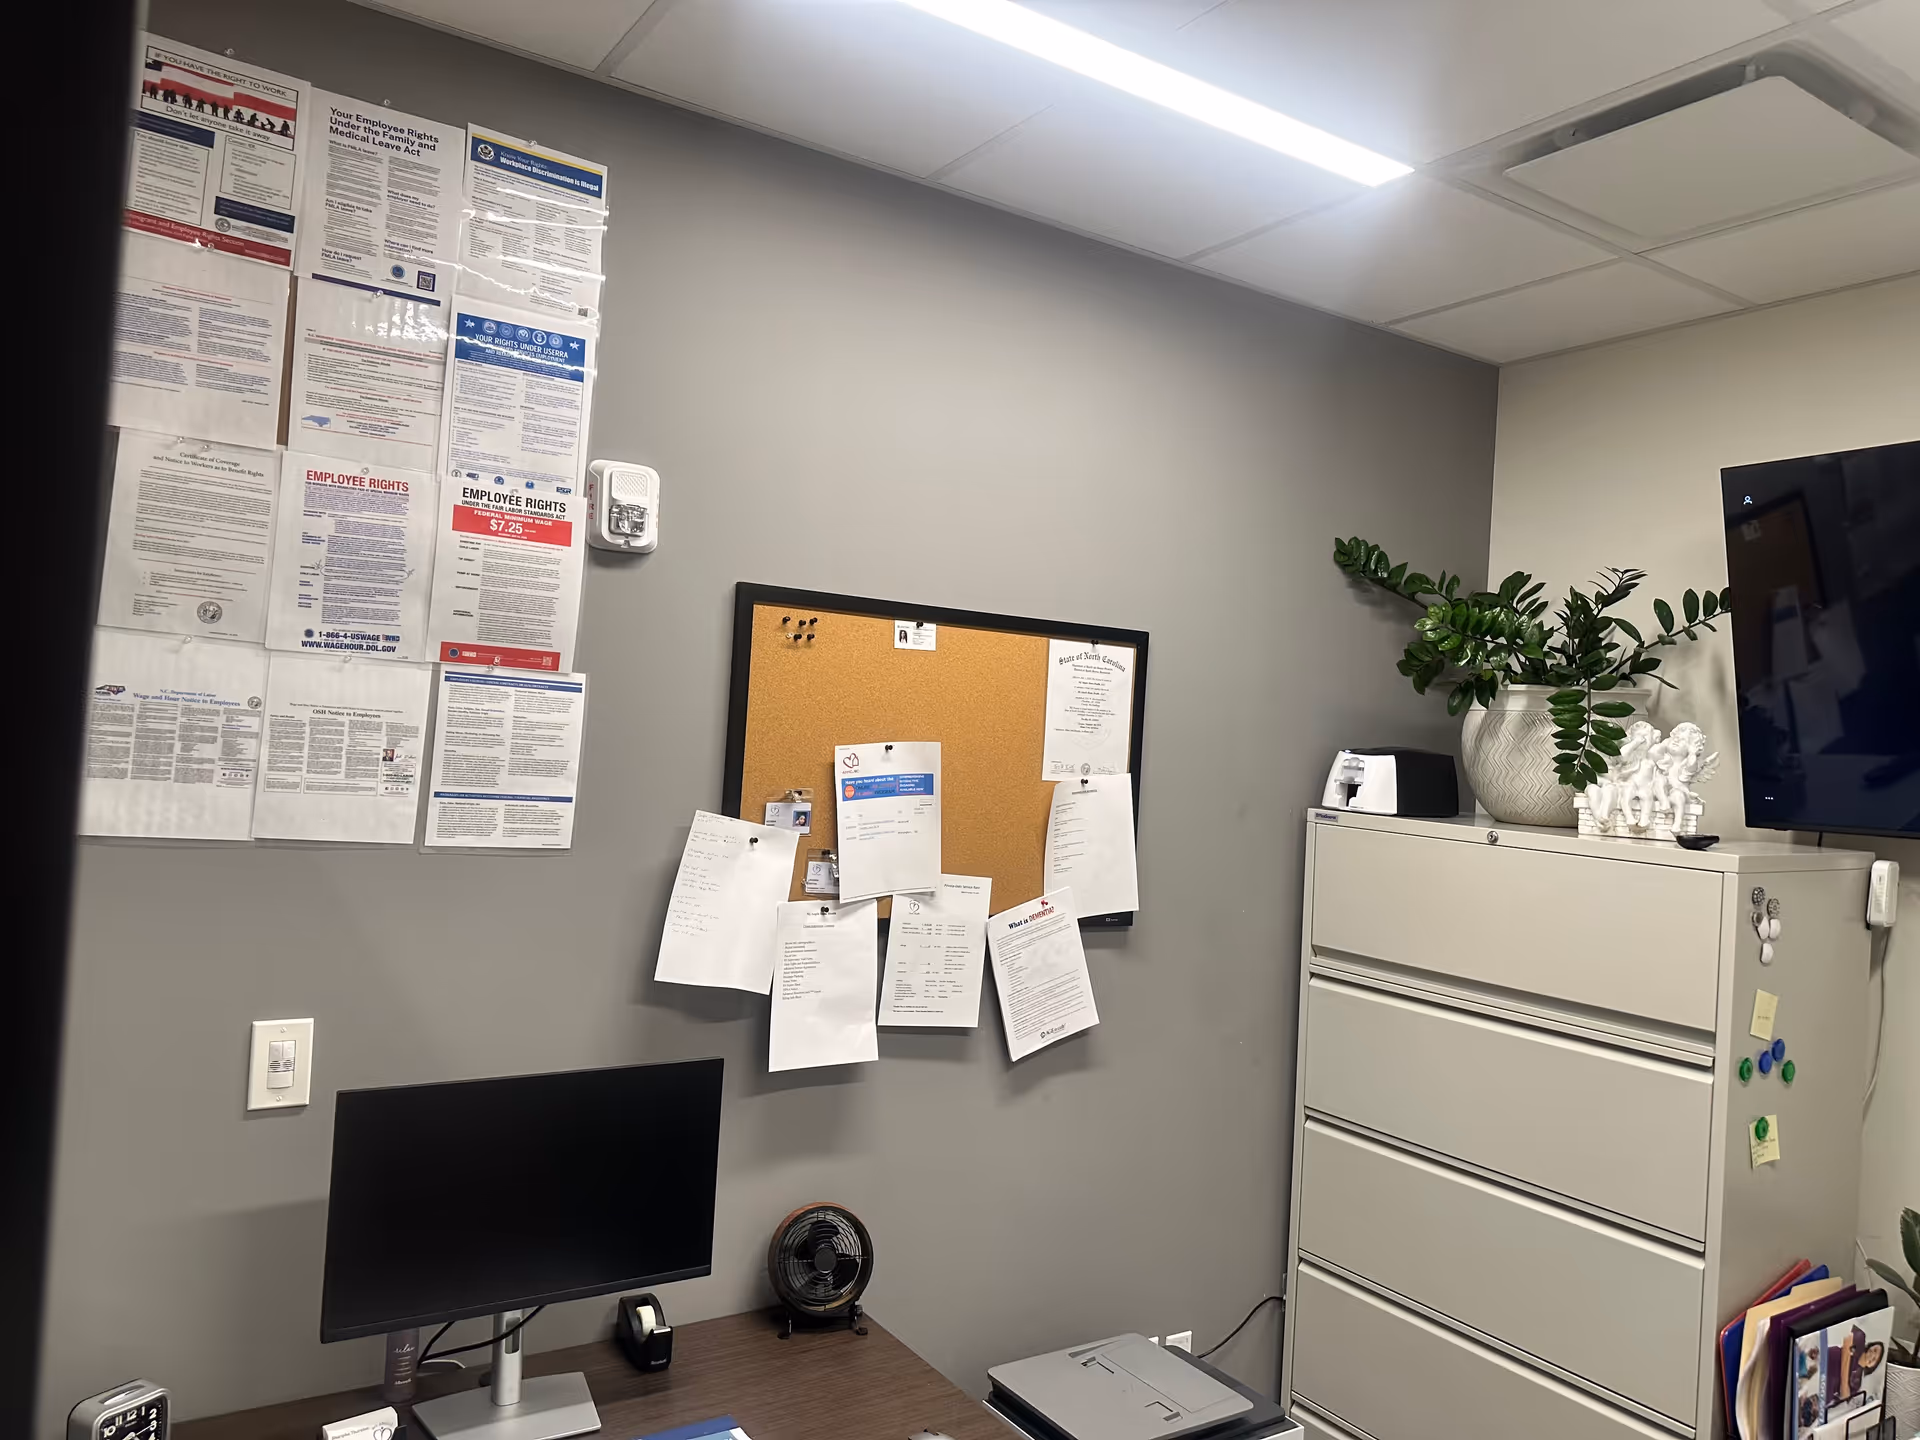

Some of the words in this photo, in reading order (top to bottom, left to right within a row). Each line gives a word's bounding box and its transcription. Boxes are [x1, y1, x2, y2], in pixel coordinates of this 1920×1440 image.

[163, 54, 182, 65] YOU
[183, 60, 205, 72] HAVE
[207, 67, 222, 78] THE
[223, 71, 246, 85] RIGHT
[248, 80, 261, 89] TO
[261, 83, 287, 97] WORK
[165, 105, 188, 118] Don't
[189, 112, 199, 121] let
[200, 117, 227, 129] anyone
[228, 123, 244, 133] take
[330, 106, 354, 120] Your
[355, 114, 405, 135] Employee
[407, 128, 439, 144] Rights
[329, 117, 361, 131] Under
[363, 126, 380, 137] the
[382, 130, 416, 147] Family
[417, 141, 436, 152] and
[329, 125, 370, 144] Medical
[372, 137, 402, 152] Leave
[403, 146, 421, 157] Act
[500, 156, 532, 172] Workplace
[532, 166, 574, 185] Discrimination
[581, 180, 599, 192] Illegal
[475, 333, 493, 344] YOUR
[494, 338, 519, 349] RIGHTS
[520, 342, 542, 353] UNDER
[543, 347, 568, 359] USERRA
[165, 456, 182, 464] Notice
[191, 460, 213, 470] Workers
[179, 452, 208, 462] Certificate
[215, 457, 240, 467] Coverage
[306, 469, 366, 488] EMPLOYEE
[369, 477, 409, 493] RIGHTS
[462, 487, 522, 507] EMPLOYEE
[525, 497, 567, 514] RIGHTS
[461, 499, 480, 508] UNDER
[481, 502, 491, 510] THE
[492, 504, 504, 512] FAIR
[505, 507, 523, 515] LABOR
[523, 510, 555, 519] STANDARDS
[473, 509, 503, 519] FEDERAL
[504, 513, 534, 524] MINIMUM
[534, 518, 553, 526] WAGE
[489, 518, 523, 534] $7.25
[318, 631, 381, 642] 1-866-4-USWAGE
[301, 640, 397, 653] WWW.WAGEHOUR.DOL.GOV
[133, 692, 150, 702] Wage
[164, 694, 180, 703] Hour
[182, 696, 201, 704] Notice
[209, 698, 241, 708] Employees
[327, 709, 345, 717] Notice
[1008, 919, 1023, 930] What
[127, 1409, 137, 1421] 12
[141, 1406, 145, 1416] 1
[149, 1408, 157, 1419] 2
[115, 1415, 122, 1426] 11
[149, 1420, 157, 1431] 3
[103, 1425, 116, 1438] 10
